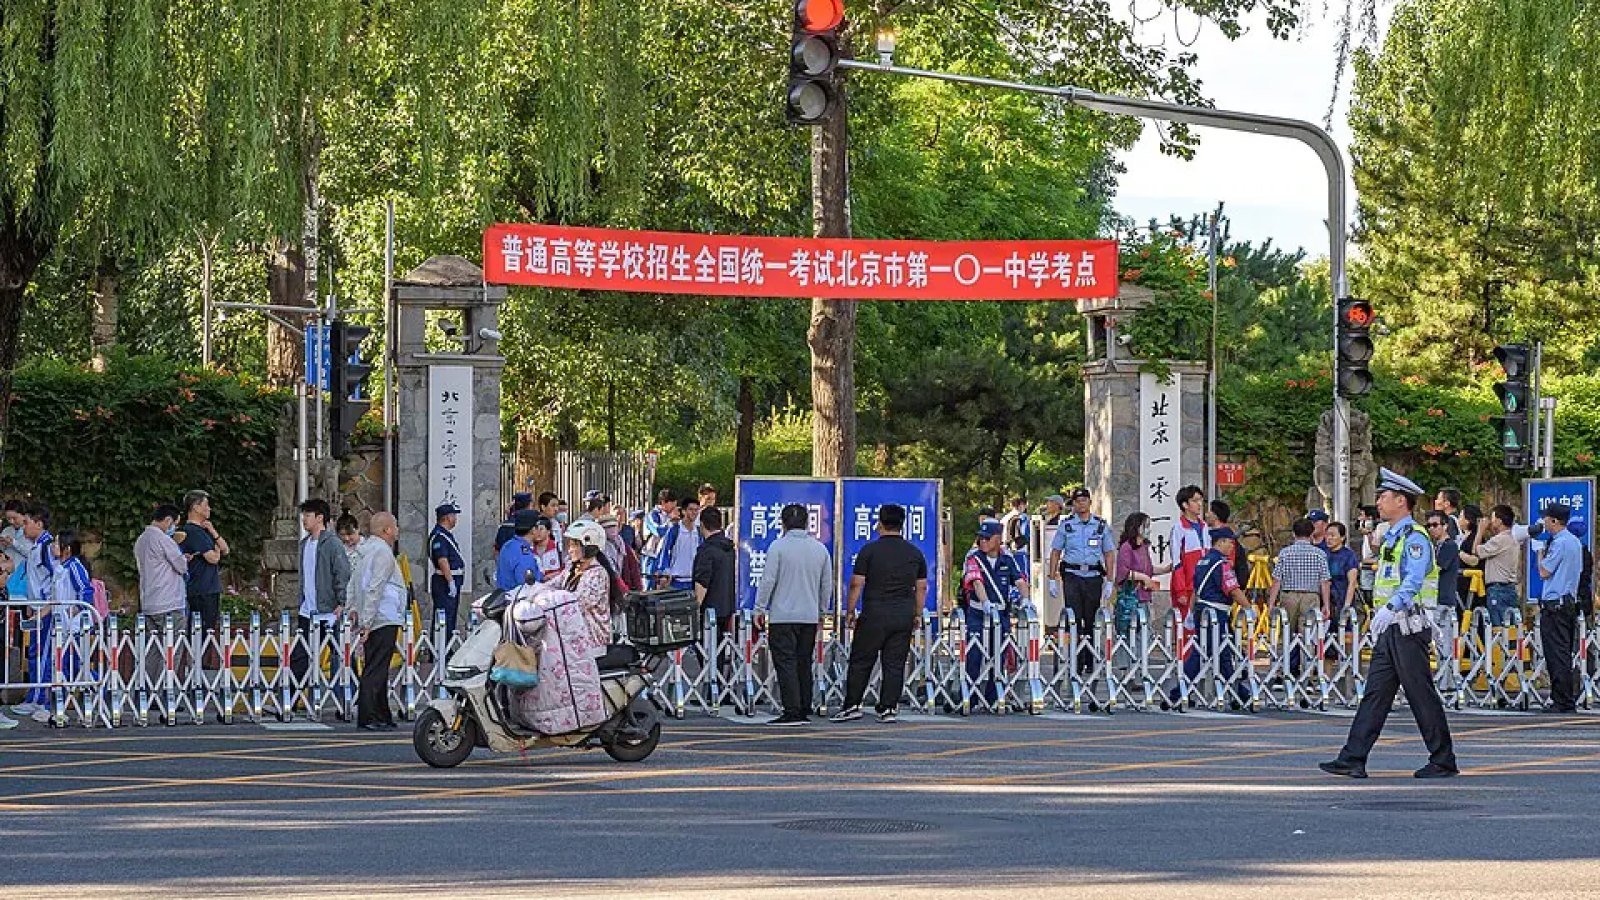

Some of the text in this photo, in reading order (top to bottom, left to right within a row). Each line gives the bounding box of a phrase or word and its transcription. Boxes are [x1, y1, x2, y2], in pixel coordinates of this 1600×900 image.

[750, 502, 821, 539] 高考间
[1149, 393, 1171, 564] 北京一零一中
